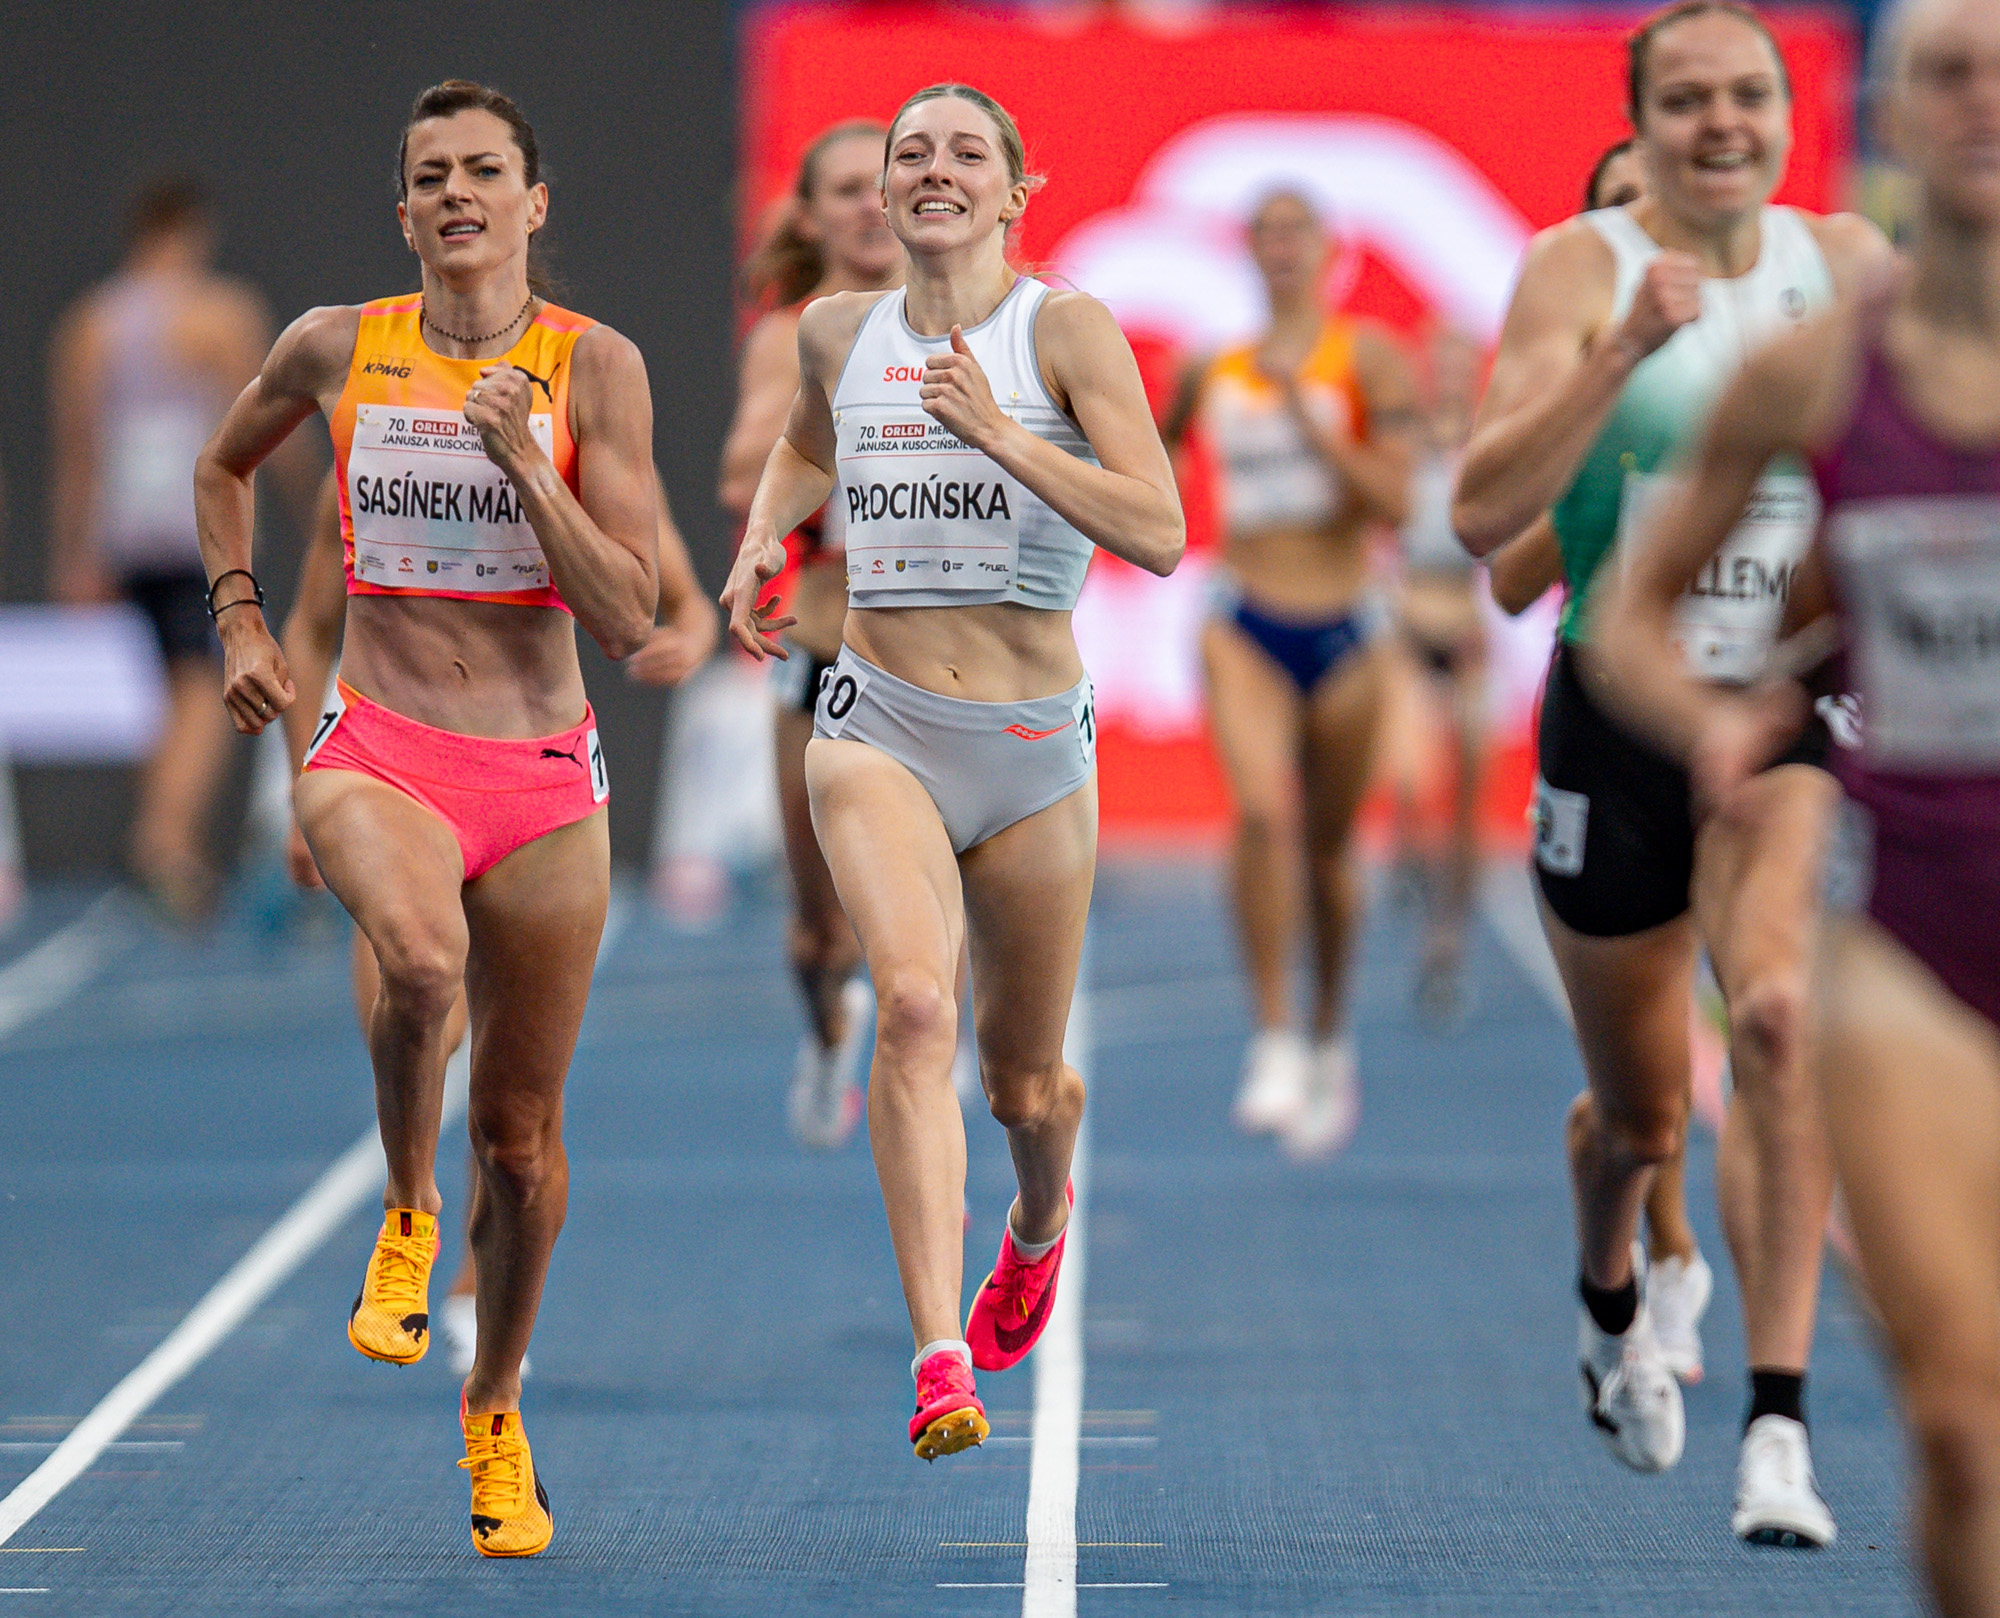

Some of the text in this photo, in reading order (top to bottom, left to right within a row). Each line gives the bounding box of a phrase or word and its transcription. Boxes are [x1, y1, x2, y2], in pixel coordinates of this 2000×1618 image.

[363, 362, 411, 379] KPMG
[883, 365, 928, 381] sau
[389, 418, 480, 436] 70. ORLEN ME
[860, 426, 878, 439] 70.
[884, 426, 924, 437] ORLEN
[382, 434, 485, 451] JANUSZA KUSOCIŃ
[856, 437, 978, 452] JANUSZA KUSOCIŃSKIE
[357, 471, 463, 522] SASÍNEK
[847, 473, 1012, 524] PŁOCIŃSKA
